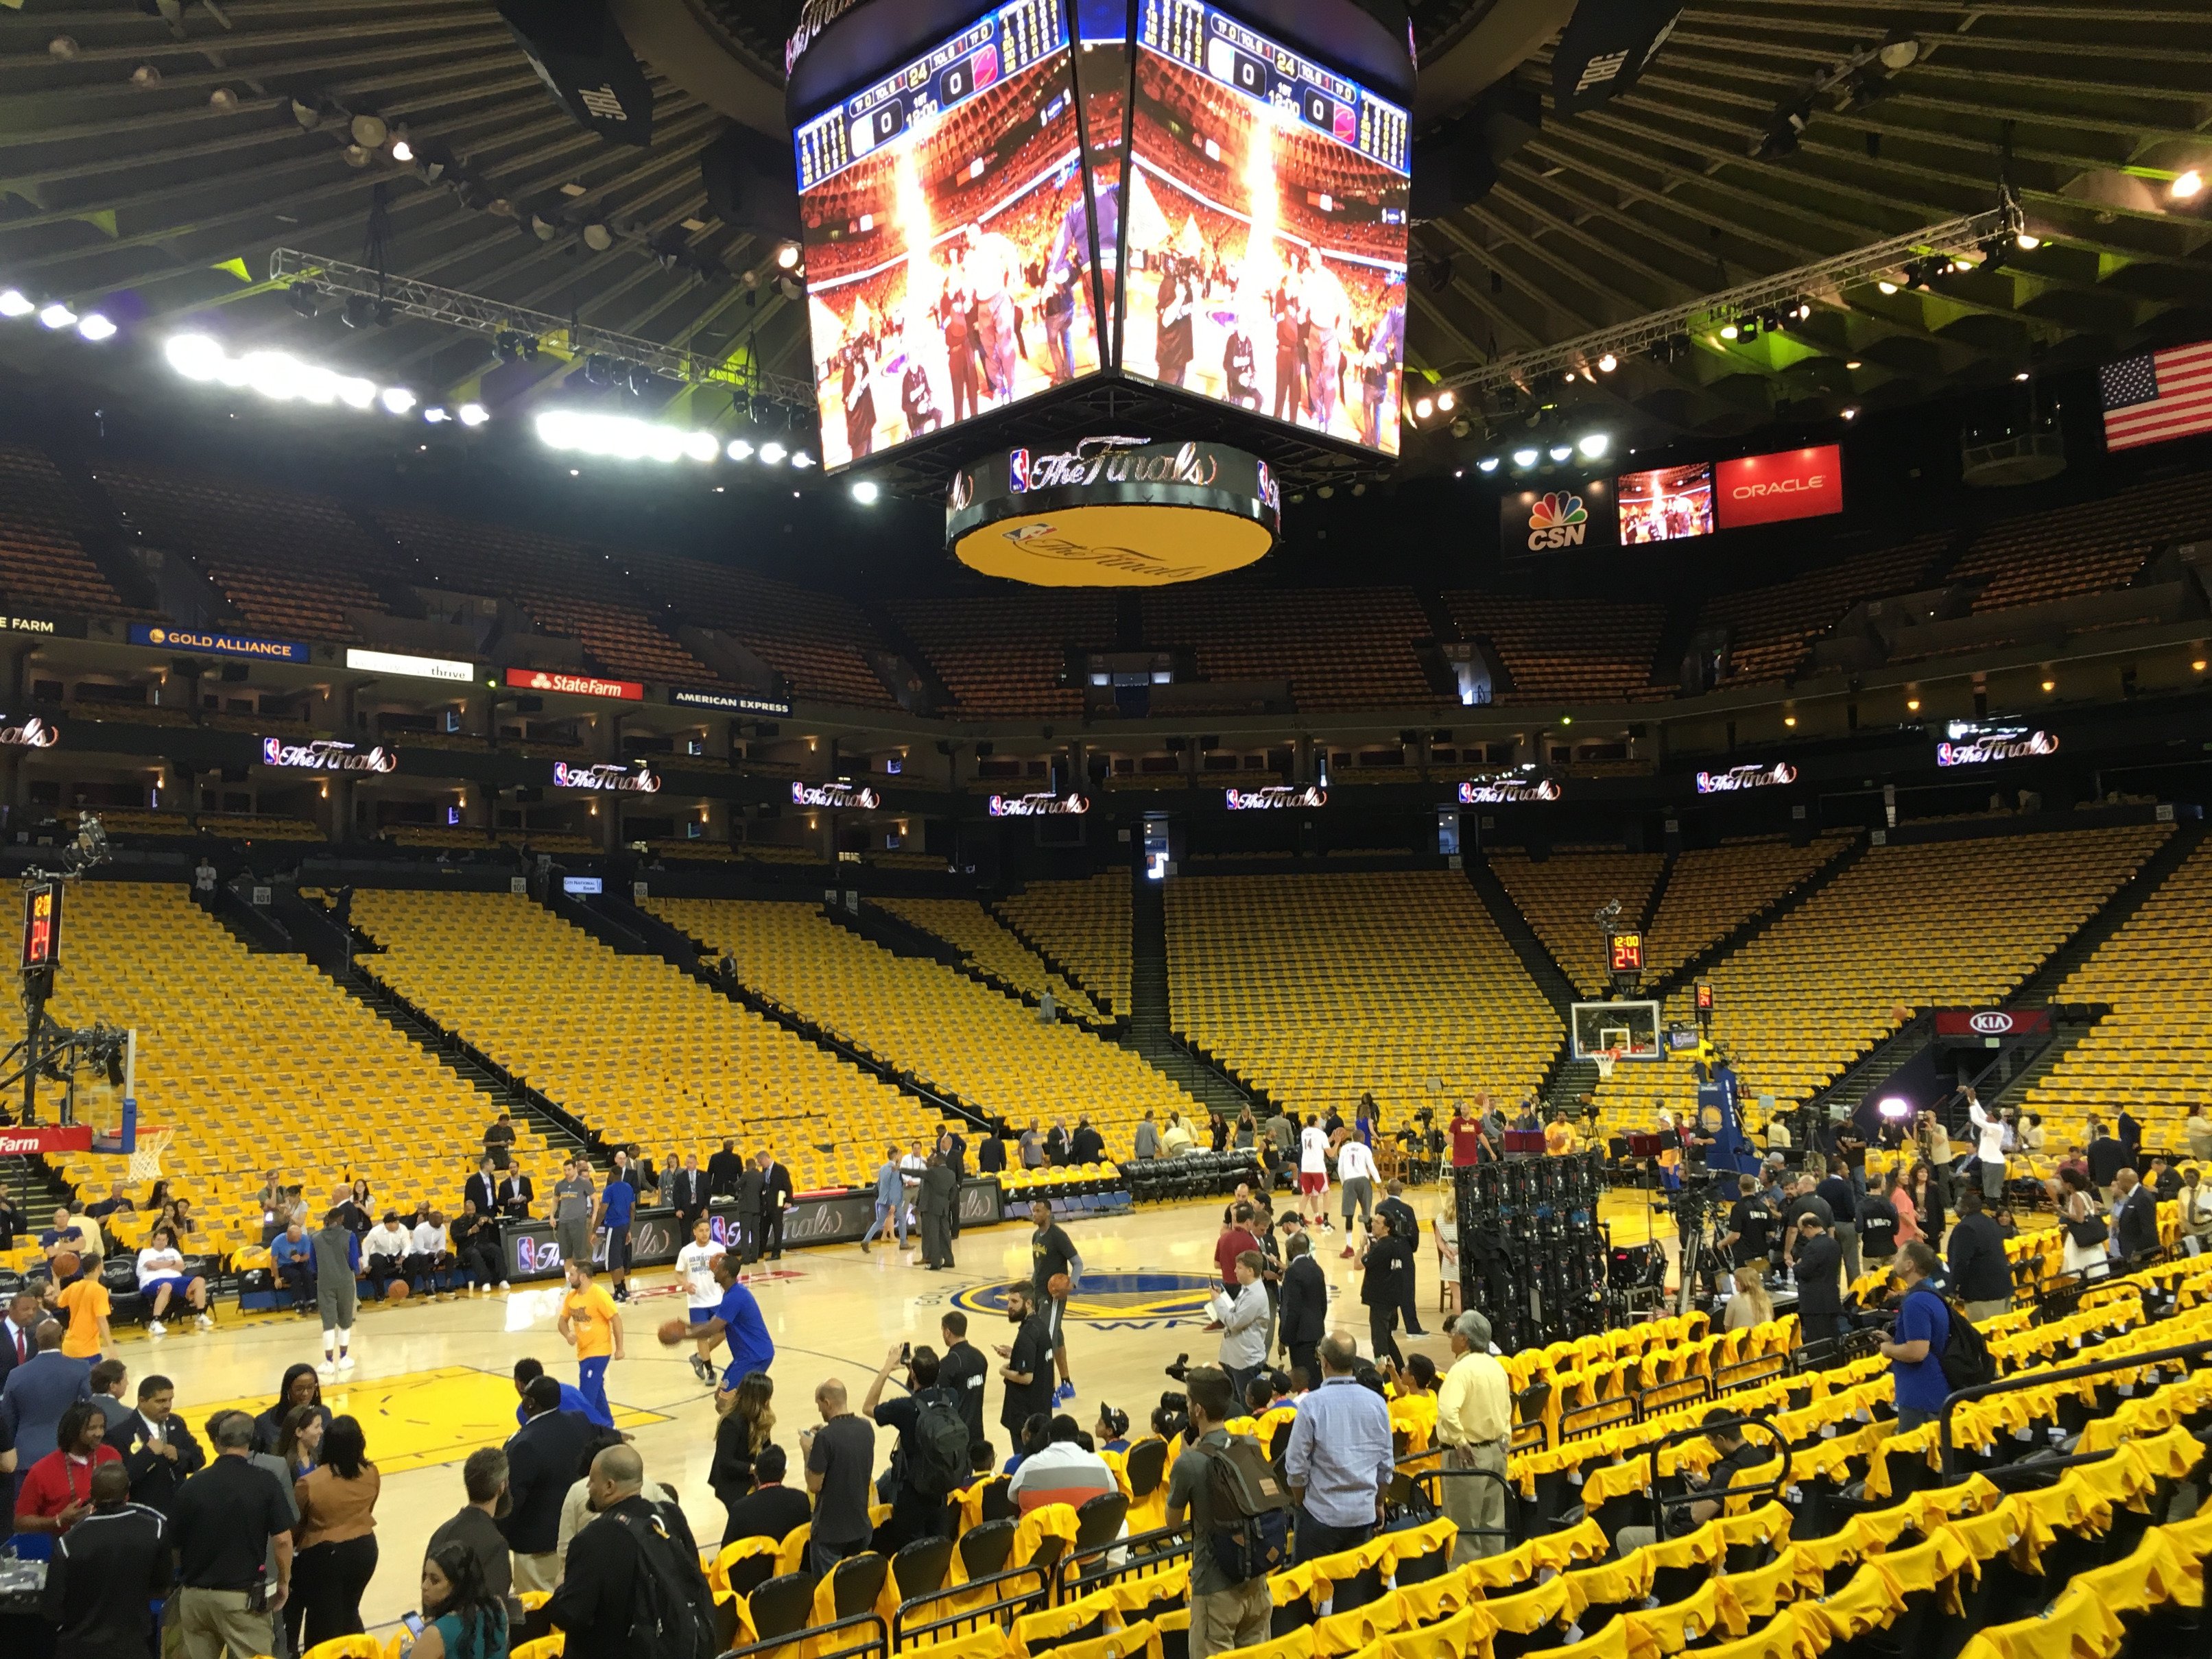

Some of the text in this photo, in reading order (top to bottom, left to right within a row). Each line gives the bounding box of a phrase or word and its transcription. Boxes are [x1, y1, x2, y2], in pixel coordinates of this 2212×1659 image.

[981, 27, 988, 38] 0
[1229, 27, 1236, 39] 0
[958, 40, 963, 52] 1
[1265, 47, 1270, 58] 1
[909, 62, 927, 86] 24
[1243, 63, 1254, 85] 0
[1277, 53, 1294, 75] 24
[898, 77, 902, 88] 1
[950, 73, 961, 94] 0
[1324, 77, 1329, 88] 1
[865, 95, 871, 107] 0
[1345, 88, 1351, 99] 0
[1313, 99, 1324, 120] 0
[881, 112, 892, 133] 0
[1030, 435, 1217, 490] The Finals
[1733, 475, 1824, 499] ORACLE
[1527, 523, 1586, 551] CSN
[1025, 538, 1213, 577] The Finals
[12, 618, 53, 633] FARM
[169, 632, 292, 656] GOLD ALLIANCE
[431, 666, 466, 679] thrive
[676, 693, 789, 713] AMERICAN EXPRESS
[0, 717, 59, 748] als
[278, 740, 397, 773] The Finals
[1951, 730, 2058, 765] The Finals
[567, 763, 661, 793] The Finals
[1708, 762, 1797, 792] The Finals
[802, 783, 880, 809] The Finals
[1237, 786, 1327, 809] The Finals
[1470, 780, 1561, 803] The Finals
[1001, 793, 1090, 816] The Finals
[32, 920, 49, 959] 24
[1615, 935, 1639, 947] 12:00
[1615, 948, 1639, 967] 24
[1977, 1016, 2006, 1029] KIA
[1304, 1138, 1312, 1150] 14
